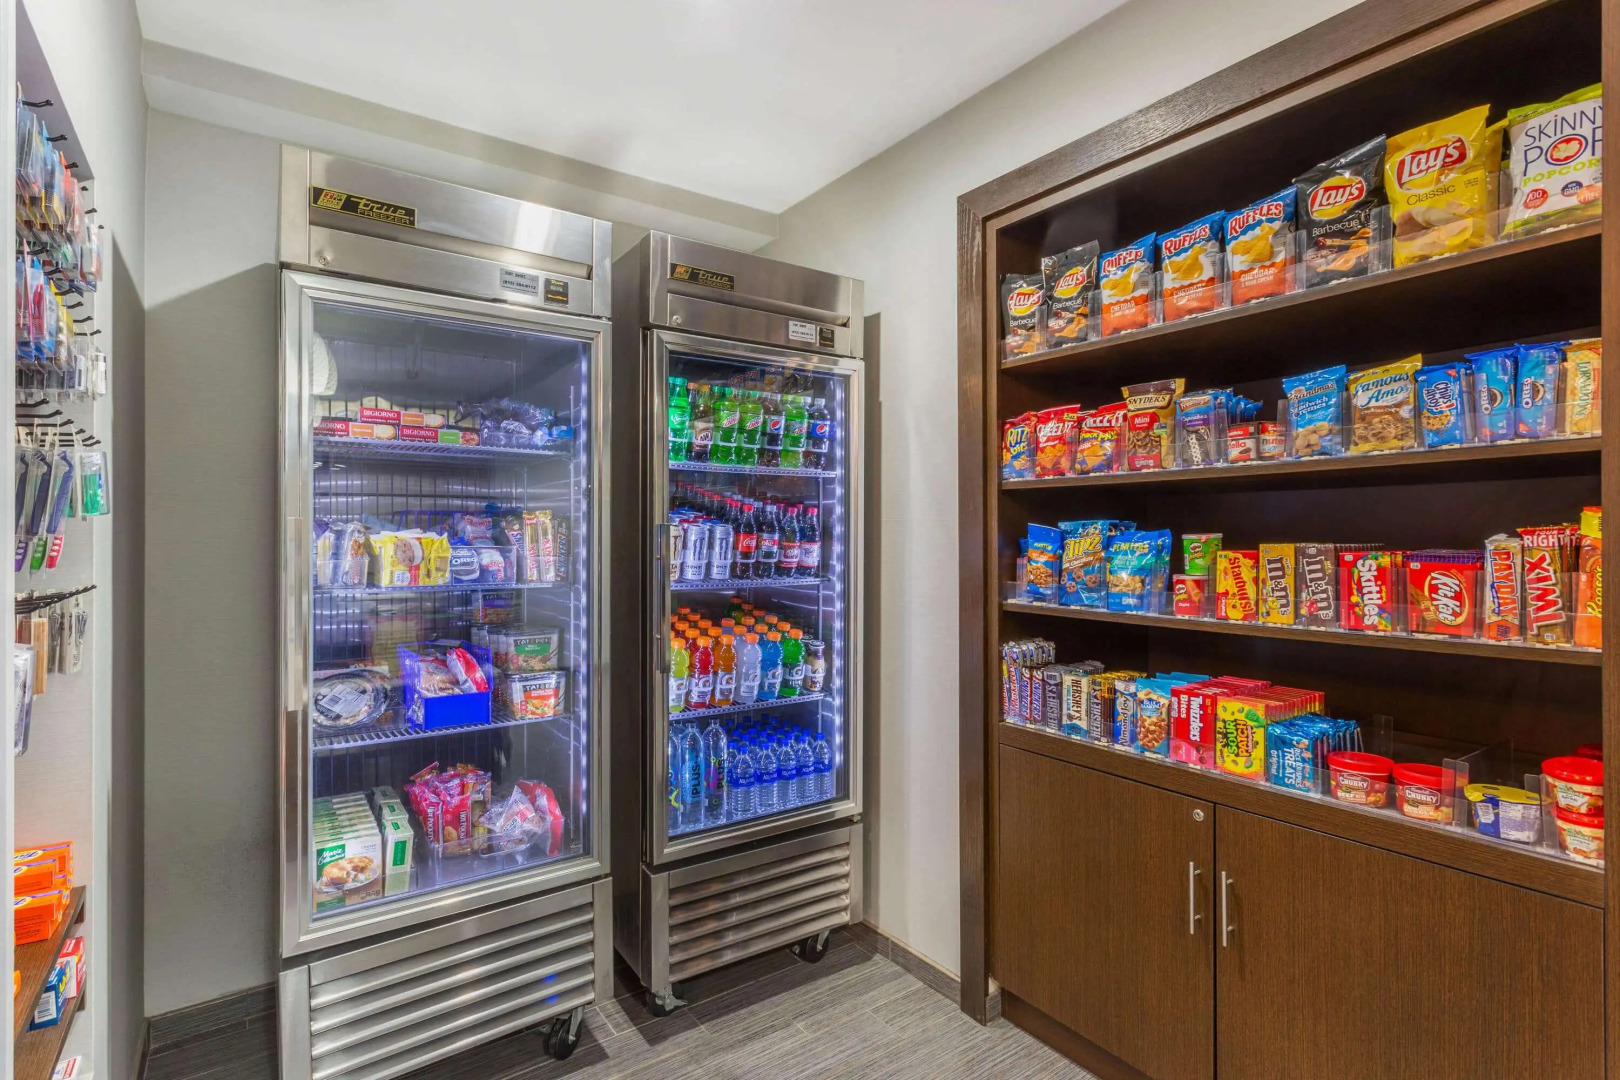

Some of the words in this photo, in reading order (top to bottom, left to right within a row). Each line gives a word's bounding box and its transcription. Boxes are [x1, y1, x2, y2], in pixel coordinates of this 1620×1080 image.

[1398, 139, 1468, 184] Lay's
[1522, 157, 1601, 188] POPCOR
[1311, 179, 1366, 212] Lay's
[1406, 183, 1457, 207] Classic
[357, 208, 411, 225] FREEZER
[1228, 201, 1284, 239] RUFFLES
[1312, 217, 1361, 238] Barbecue
[1163, 224, 1210, 256] RUFFLES
[1053, 268, 1088, 293] Lay's
[1052, 297, 1084, 311] Barbecue
[1009, 317, 1038, 327] Barbecue
[1352, 371, 1410, 399] Famous
[1360, 382, 1411, 408] Amos
[1480, 384, 1492, 415] OREO
[1522, 377, 1534, 410] OREO
[363, 408, 398, 419] DIGIORNO
[1134, 415, 1151, 424] Mini
[403, 428, 435, 438] DIGIORNO
[1007, 426, 1029, 448] RITZ
[1112, 541, 1150, 554] PLANTERS
[1523, 534, 1564, 548] RIGHT
[1228, 556, 1256, 614] Starburst
[1356, 558, 1382, 627] Skittles
[1490, 549, 1520, 619] PAYDAY
[1523, 551, 1566, 635] TWIX
[1032, 680, 1042, 718] SNICKERS
[1046, 684, 1059, 730] HERSHEY'S
[1070, 678, 1082, 722] HERSHEY'S
[1089, 687, 1102, 741] HERSHEY'S
[1122, 695, 1131, 714] Joy
[1180, 694, 1189, 719] Bites
[1119, 713, 1130, 746] Almond
[1189, 695, 1204, 742] Twizzlers
[1225, 719, 1238, 755] SOUR
[1236, 719, 1250, 758] PATCH
[1284, 747, 1296, 785] TREATS
[1294, 747, 1302, 762] RICE
[691, 766, 700, 796] PLUS
[716, 756, 724, 790] PLUS
[1339, 776, 1369, 789] CHUNKY
[1405, 789, 1439, 804] CHUNKY
[459, 821, 467, 840] POCKE
